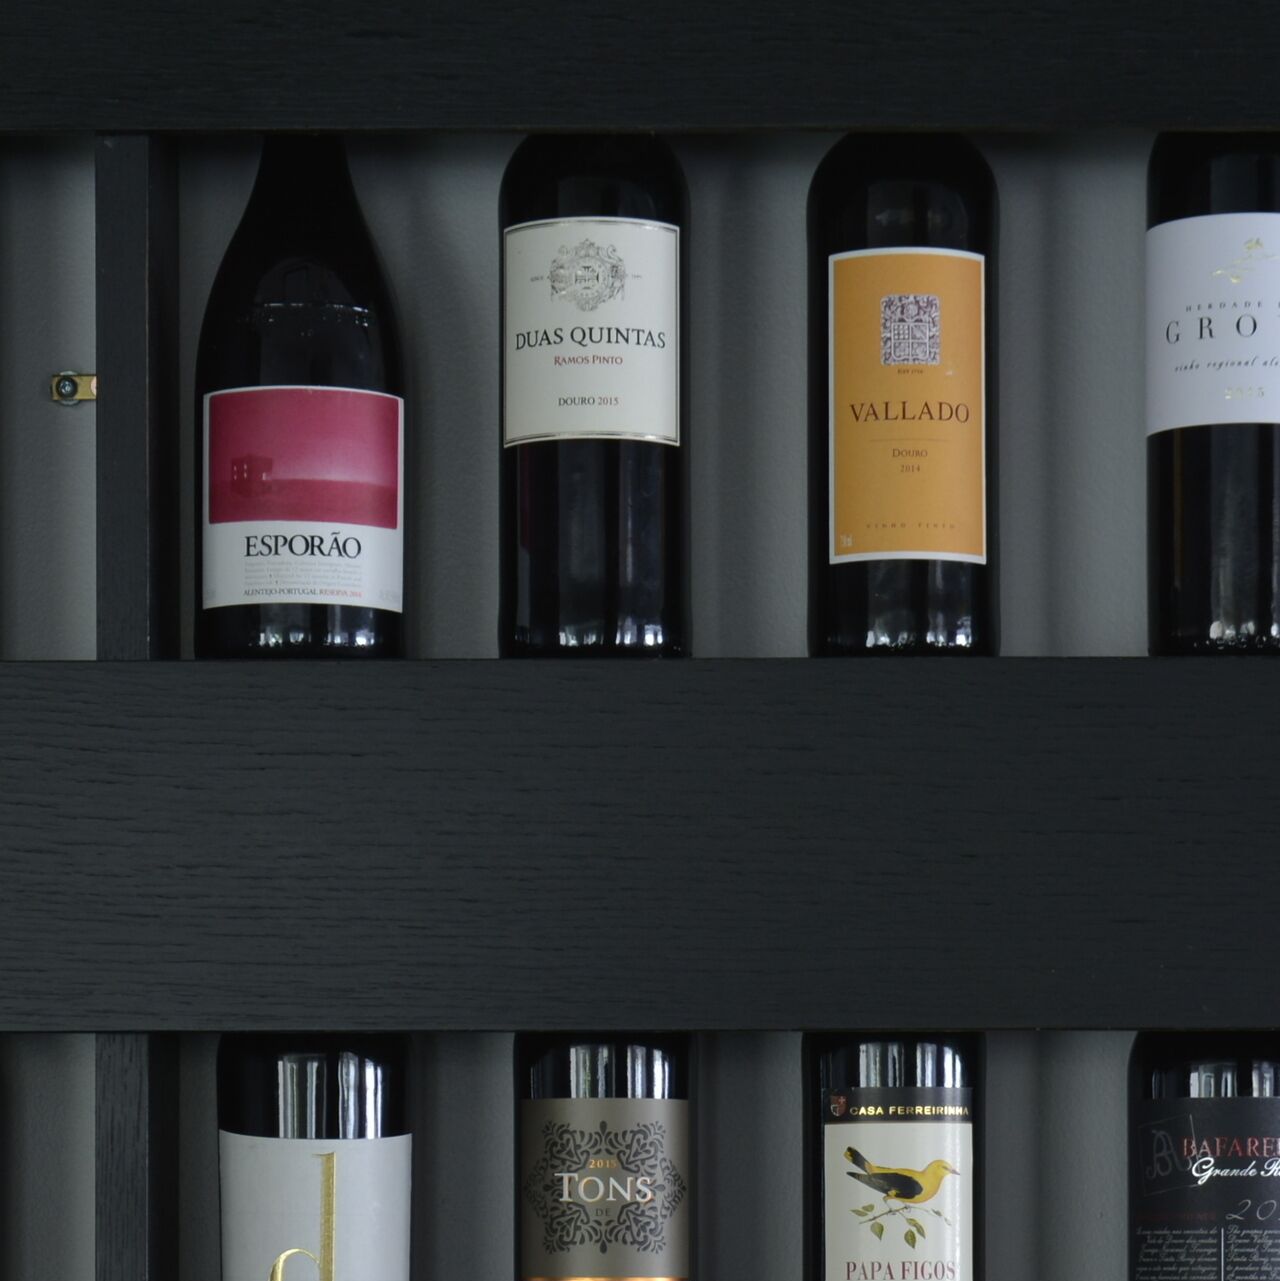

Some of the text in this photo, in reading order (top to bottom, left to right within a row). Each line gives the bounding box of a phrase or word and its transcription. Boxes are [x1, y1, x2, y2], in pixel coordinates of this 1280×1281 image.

[1185, 302, 1262, 313] HERDADE
[515, 326, 666, 351] DUAS QUINTAS
[553, 354, 623, 367] RAMOS PINTO
[557, 397, 619, 408] DOURO 2015
[849, 400, 970, 424] VALLADO
[891, 448, 929, 459] DOURO
[900, 464, 921, 474] 2014
[245, 531, 362, 560] ESPORÃO
[849, 1105, 970, 1117] CASA FERREIRINHA
[588, 1159, 618, 1169] 2015
[1191, 1156, 1258, 1186] Grande
[554, 1172, 656, 1204] TONS
[846, 1260, 957, 1281] PAPA FIGOS
